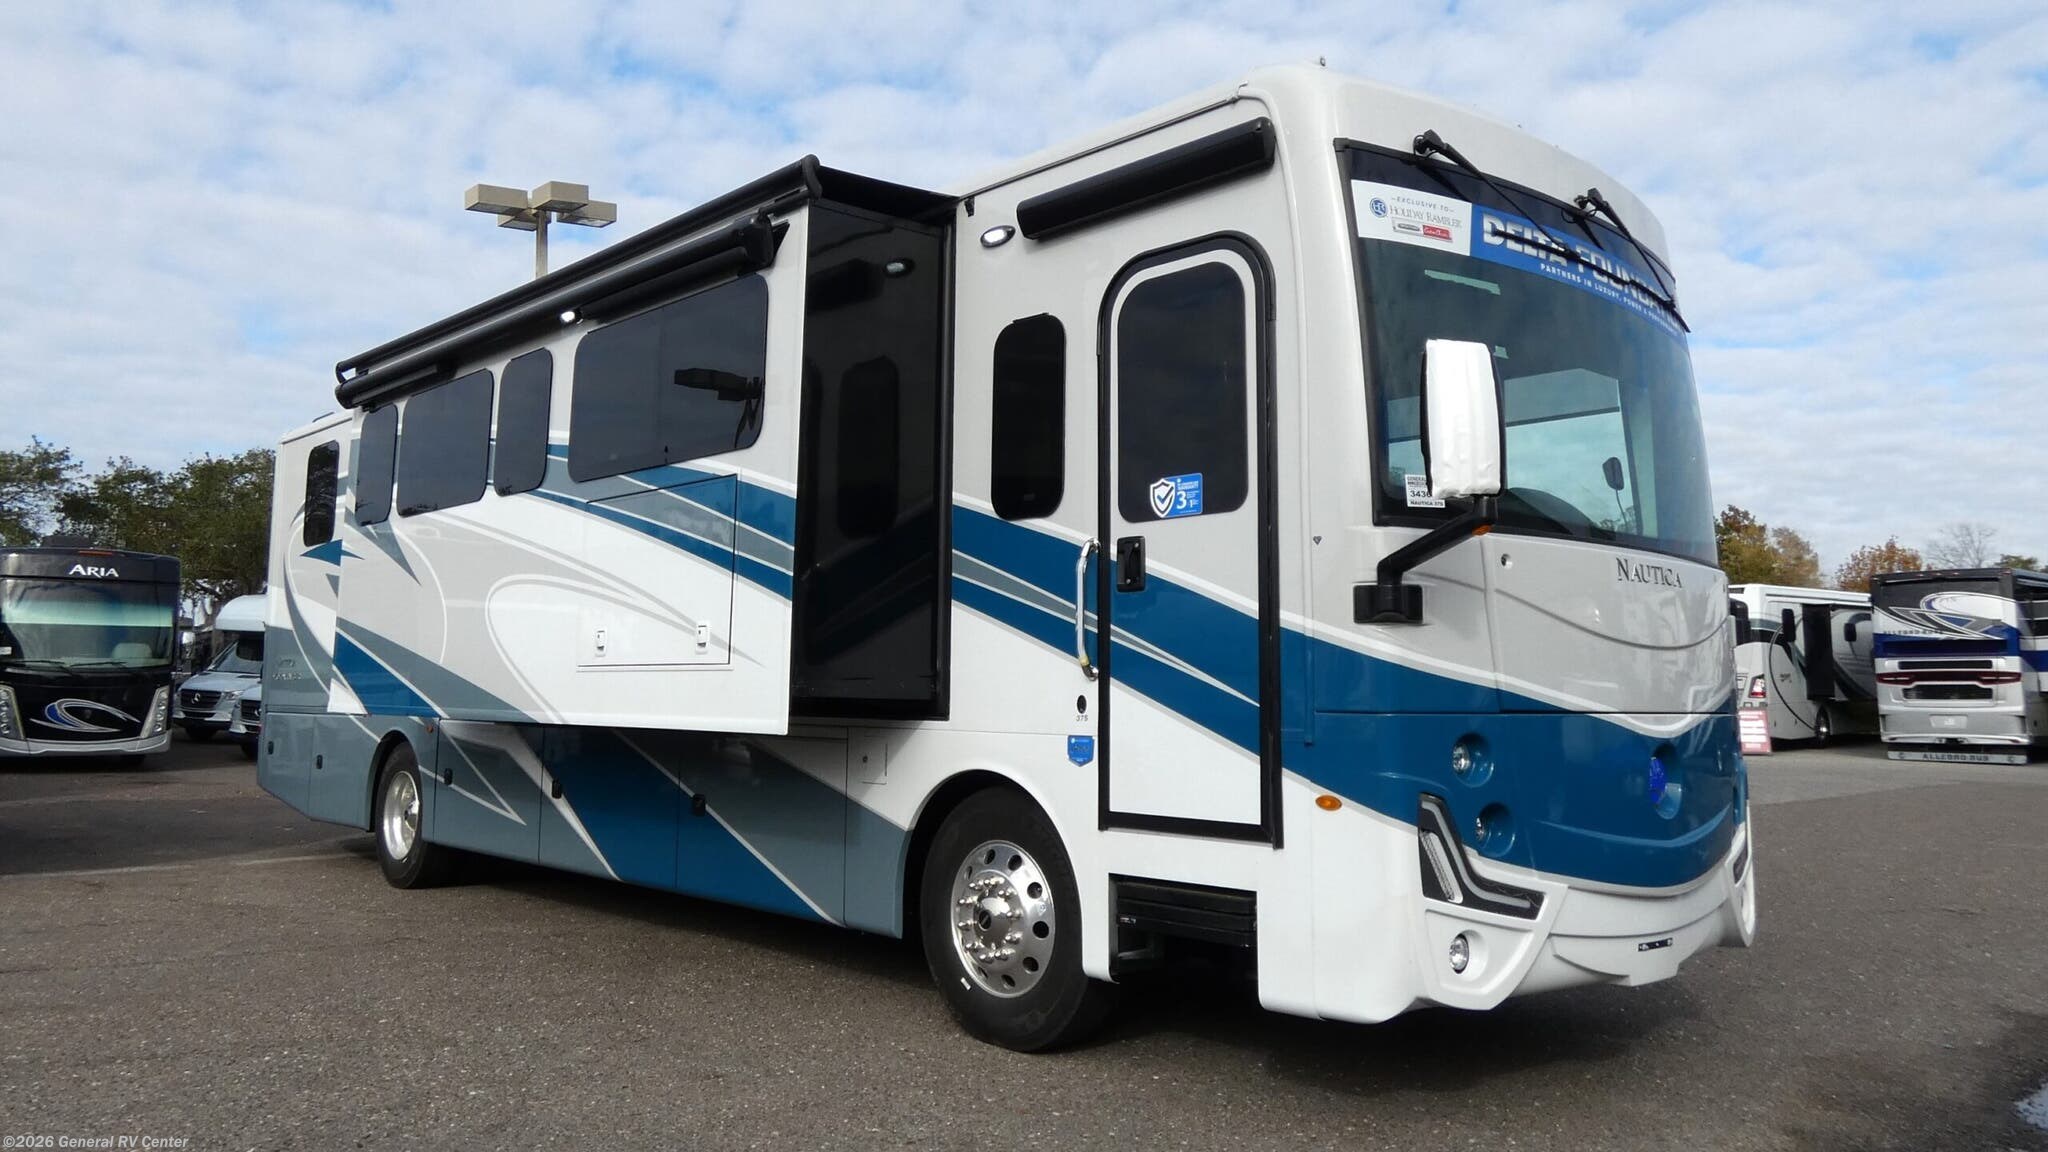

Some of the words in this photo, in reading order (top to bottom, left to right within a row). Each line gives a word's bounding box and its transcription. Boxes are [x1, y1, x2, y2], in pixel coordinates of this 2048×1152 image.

[1396, 196, 1437, 210] EXCLUSIVE
[1440, 203, 1450, 213] TO
[1540, 262, 1582, 284] PARTNERS
[1584, 278, 1593, 288] IN
[1176, 490, 1187, 509] 3
[69, 564, 119, 579] ARIA
[1616, 557, 1683, 589] NAUTICA
